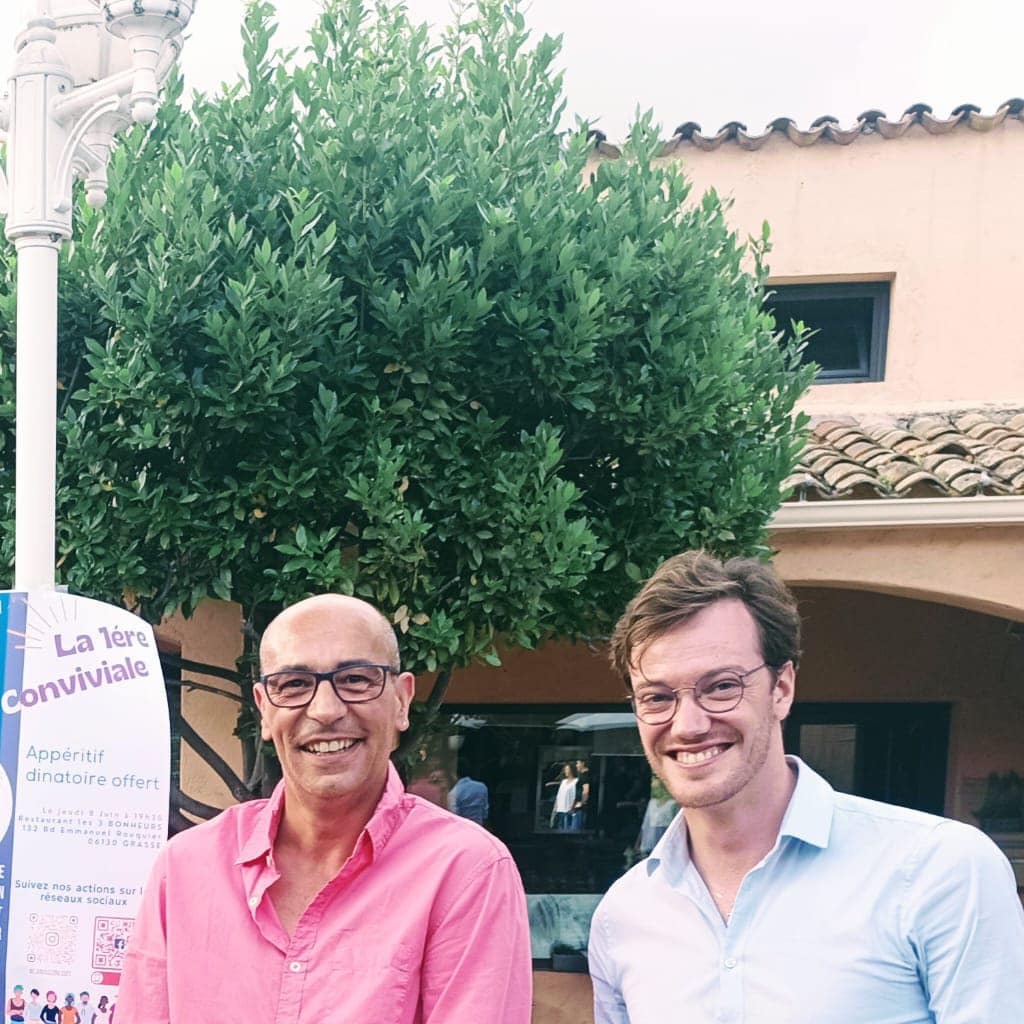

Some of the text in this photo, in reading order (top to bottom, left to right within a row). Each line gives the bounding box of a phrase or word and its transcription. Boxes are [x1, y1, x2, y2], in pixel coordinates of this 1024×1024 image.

[54, 634, 94, 657] La
[1, 657, 149, 714] conviviale
[26, 745, 104, 763] Appéritif
[26, 768, 159, 790] dinatoire offert
[15, 880, 49, 891] Suivez
[52, 883, 72, 892] nos
[75, 884, 116, 895] actions
[119, 887, 136, 896] sur
[40, 892, 128, 906] réseaux sociaux
